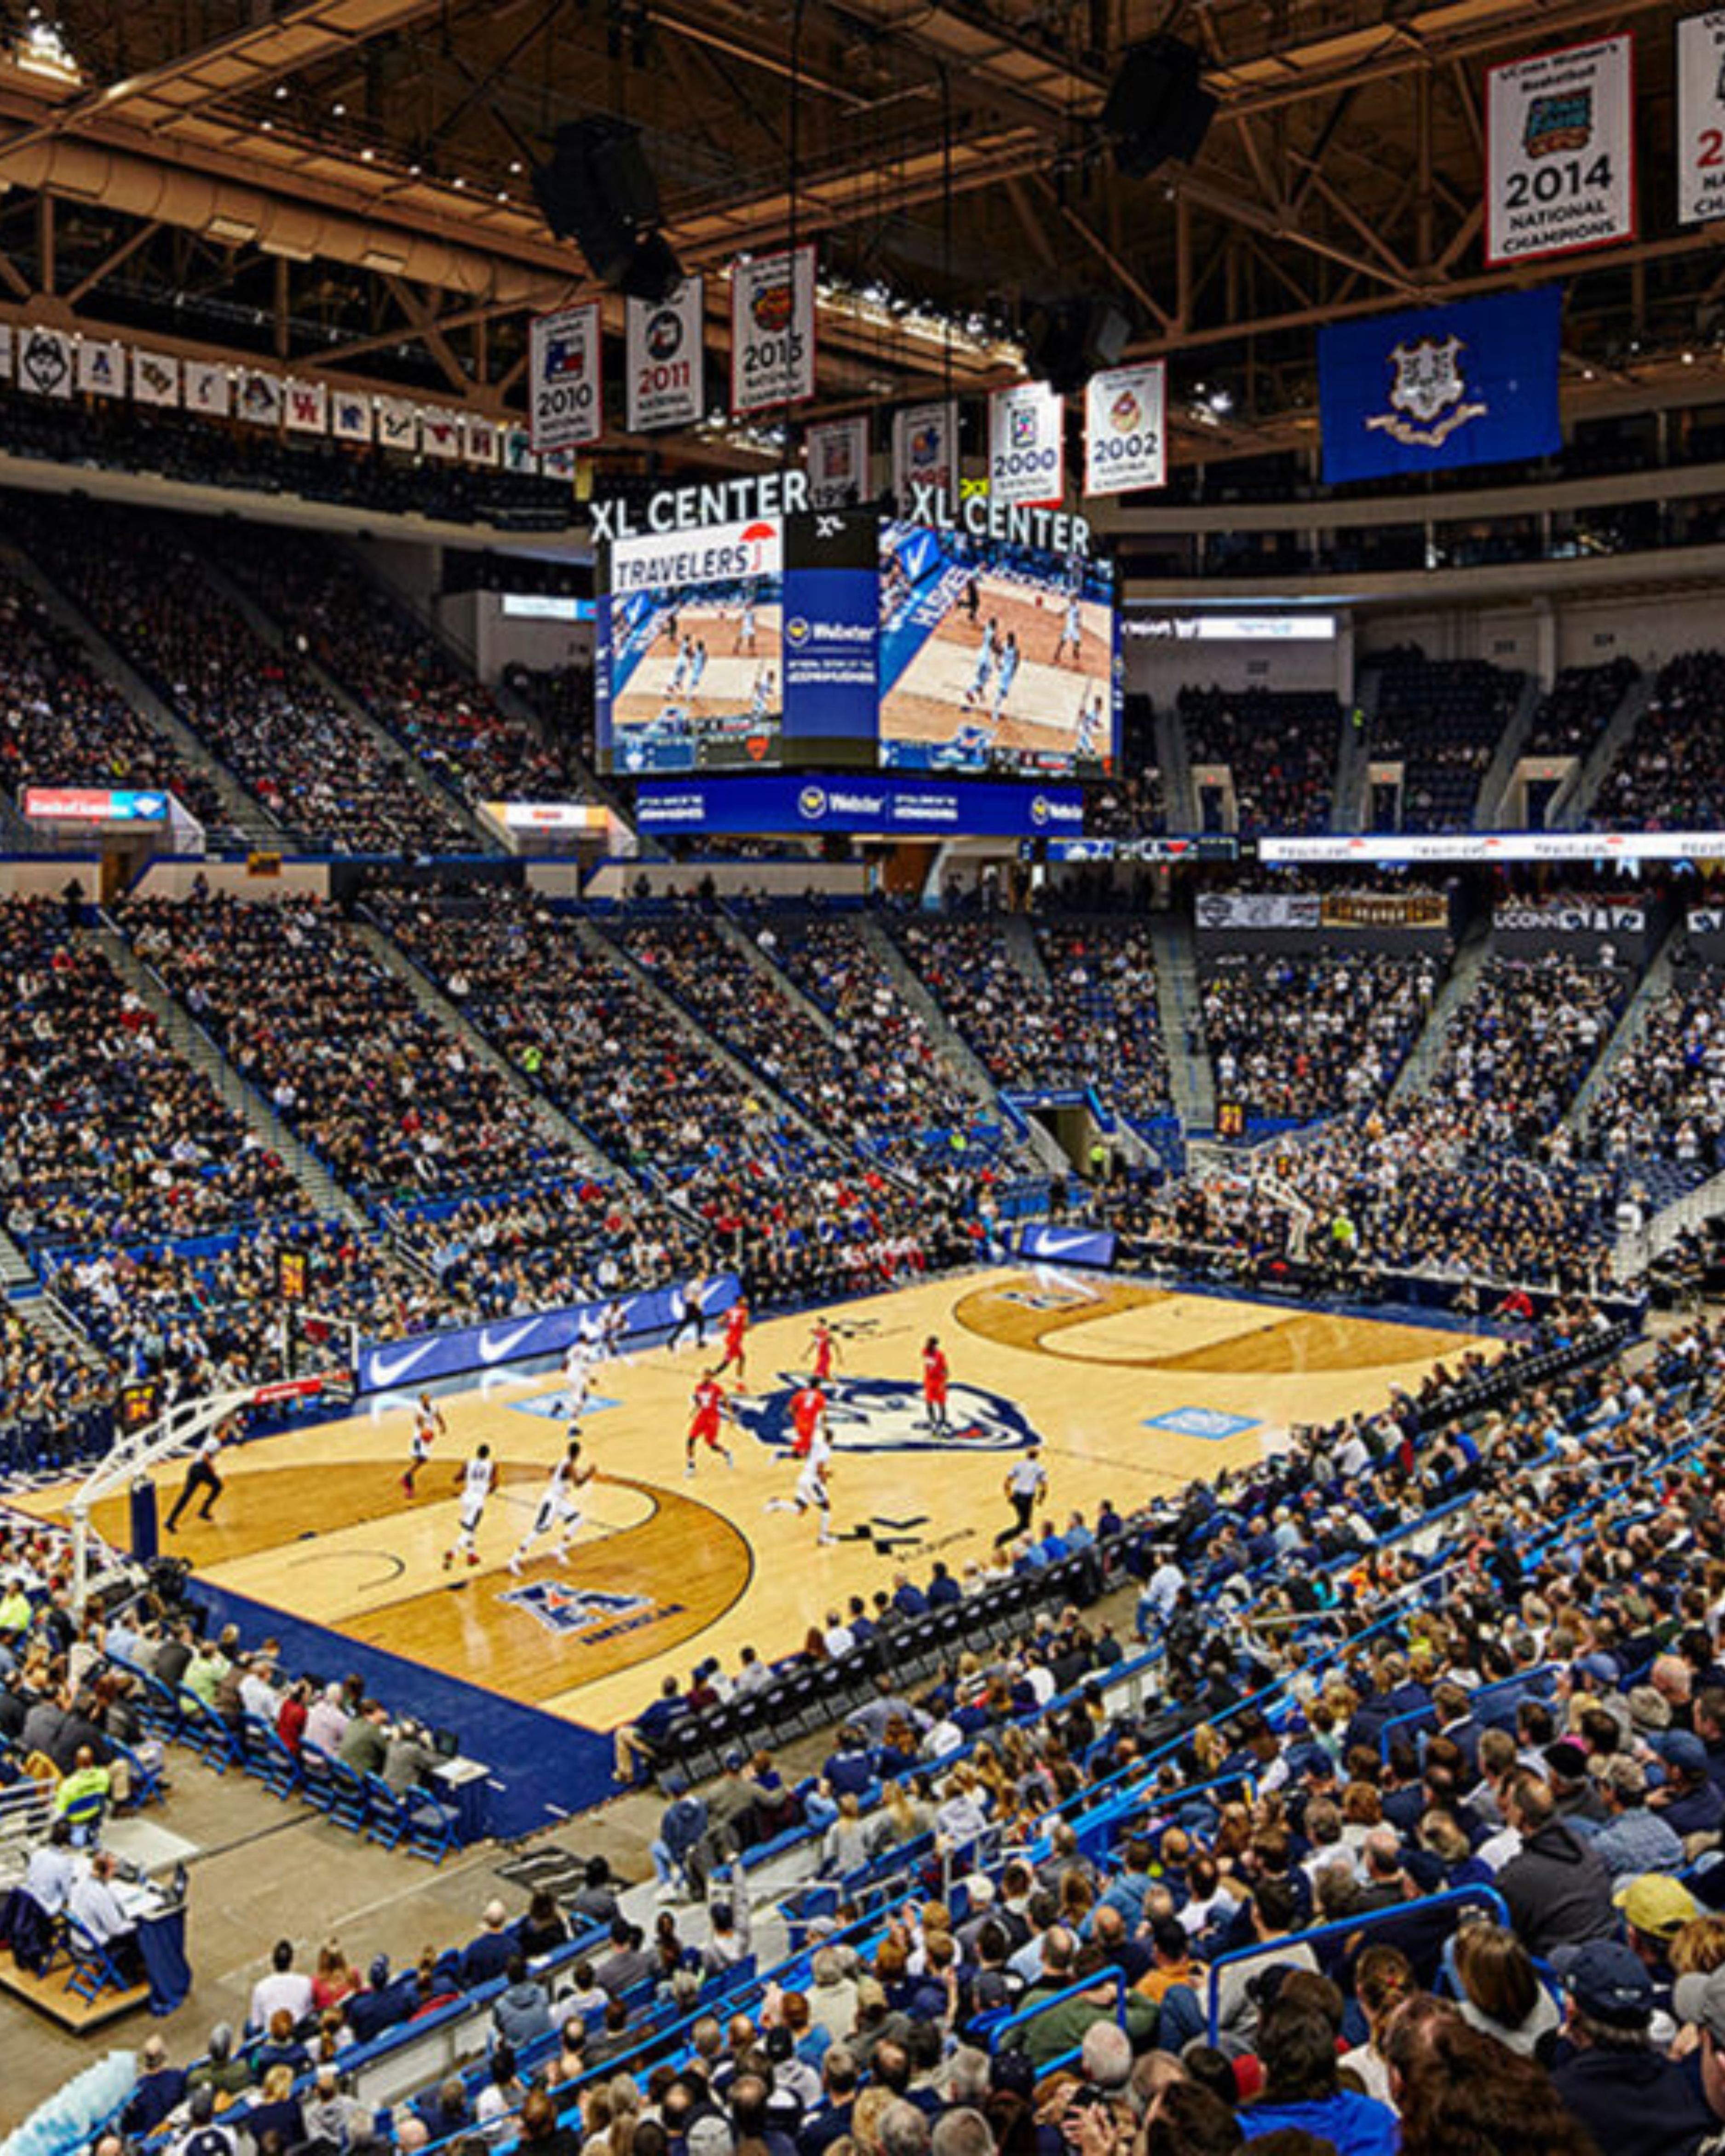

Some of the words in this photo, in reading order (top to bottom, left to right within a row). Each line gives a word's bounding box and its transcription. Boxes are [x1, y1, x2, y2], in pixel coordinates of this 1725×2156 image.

[1505, 153, 1614, 210] 2014
[1509, 199, 1607, 231] NATIONAL
[1502, 217, 1616, 254] CHAMPIONS
[638, 360, 690, 395] 2011
[538, 383, 594, 417] 2010
[994, 447, 1058, 477] 2000
[1093, 430, 1159, 463] 2002
[588, 498, 637, 543] XL
[648, 469, 809, 533] CENTER
[911, 481, 955, 529] XL
[964, 495, 1090, 557] CENTER
[616, 545, 748, 588] TRAVELERS
